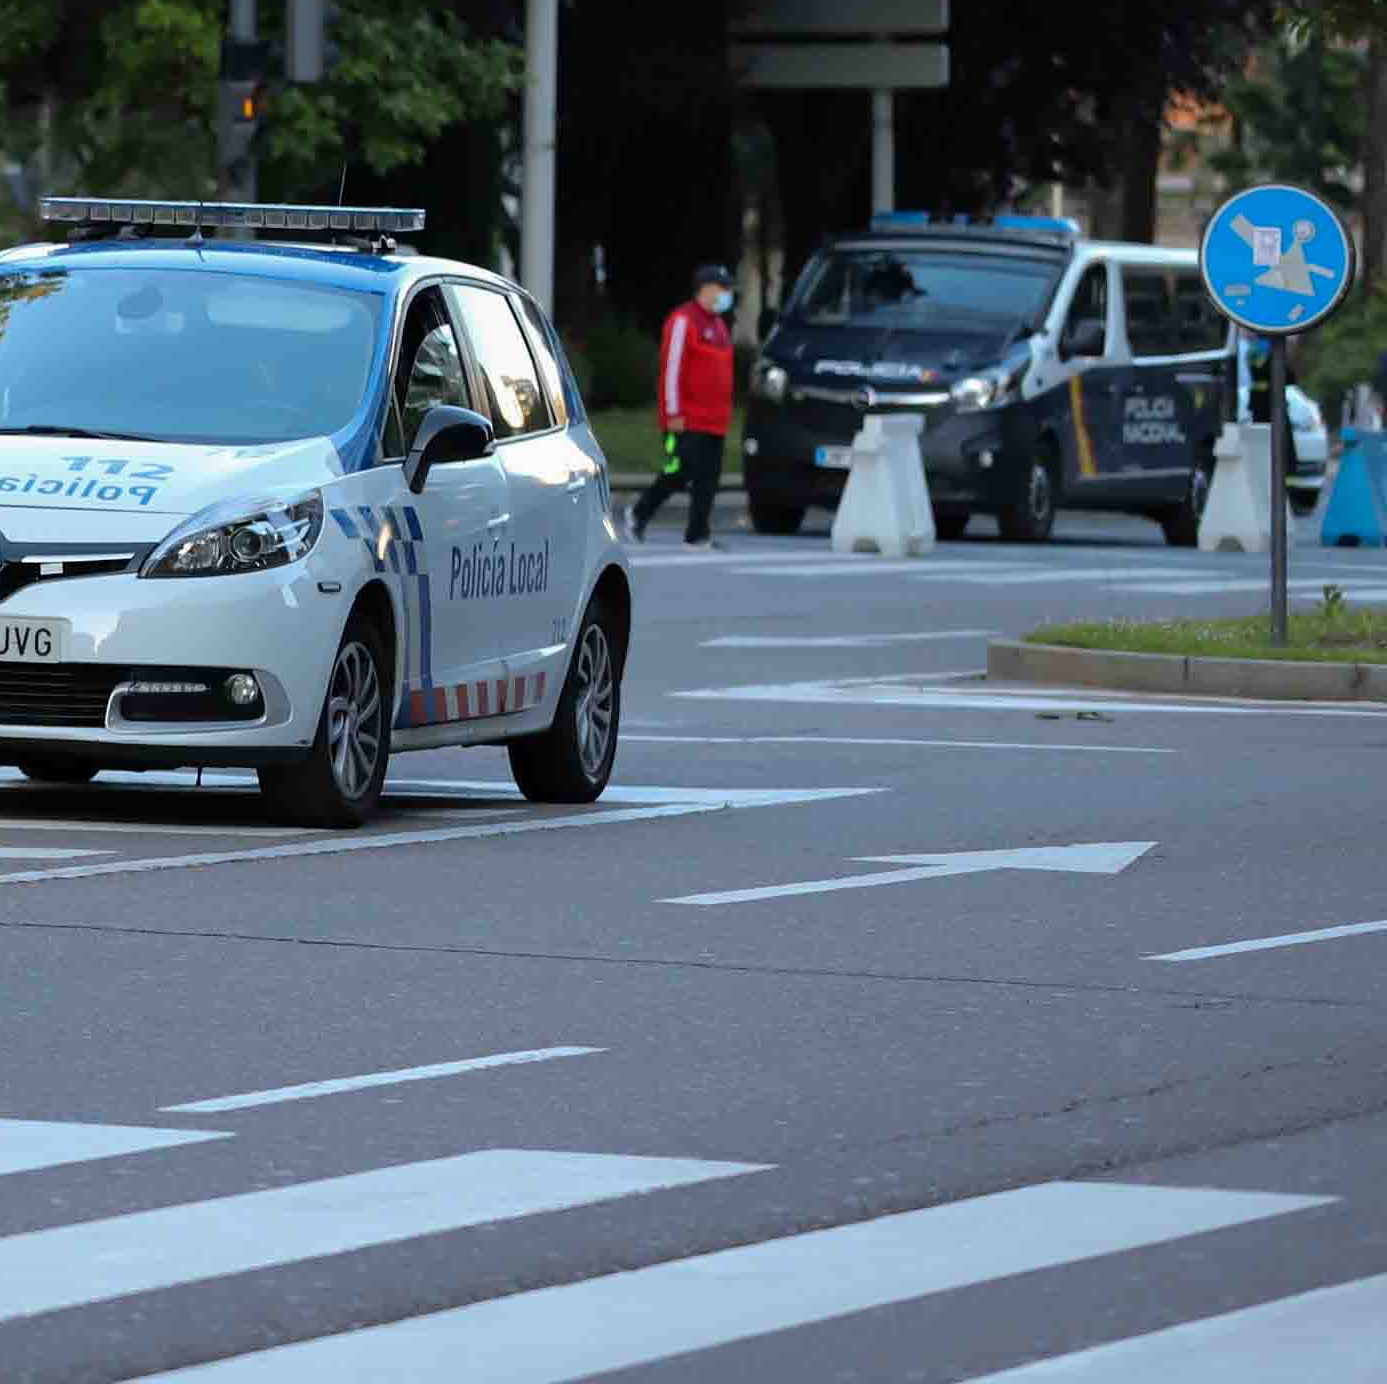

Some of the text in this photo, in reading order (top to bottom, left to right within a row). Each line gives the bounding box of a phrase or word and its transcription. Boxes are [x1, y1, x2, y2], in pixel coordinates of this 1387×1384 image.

[61, 455, 174, 480] 112
[449, 538, 549, 600] Policía Local
